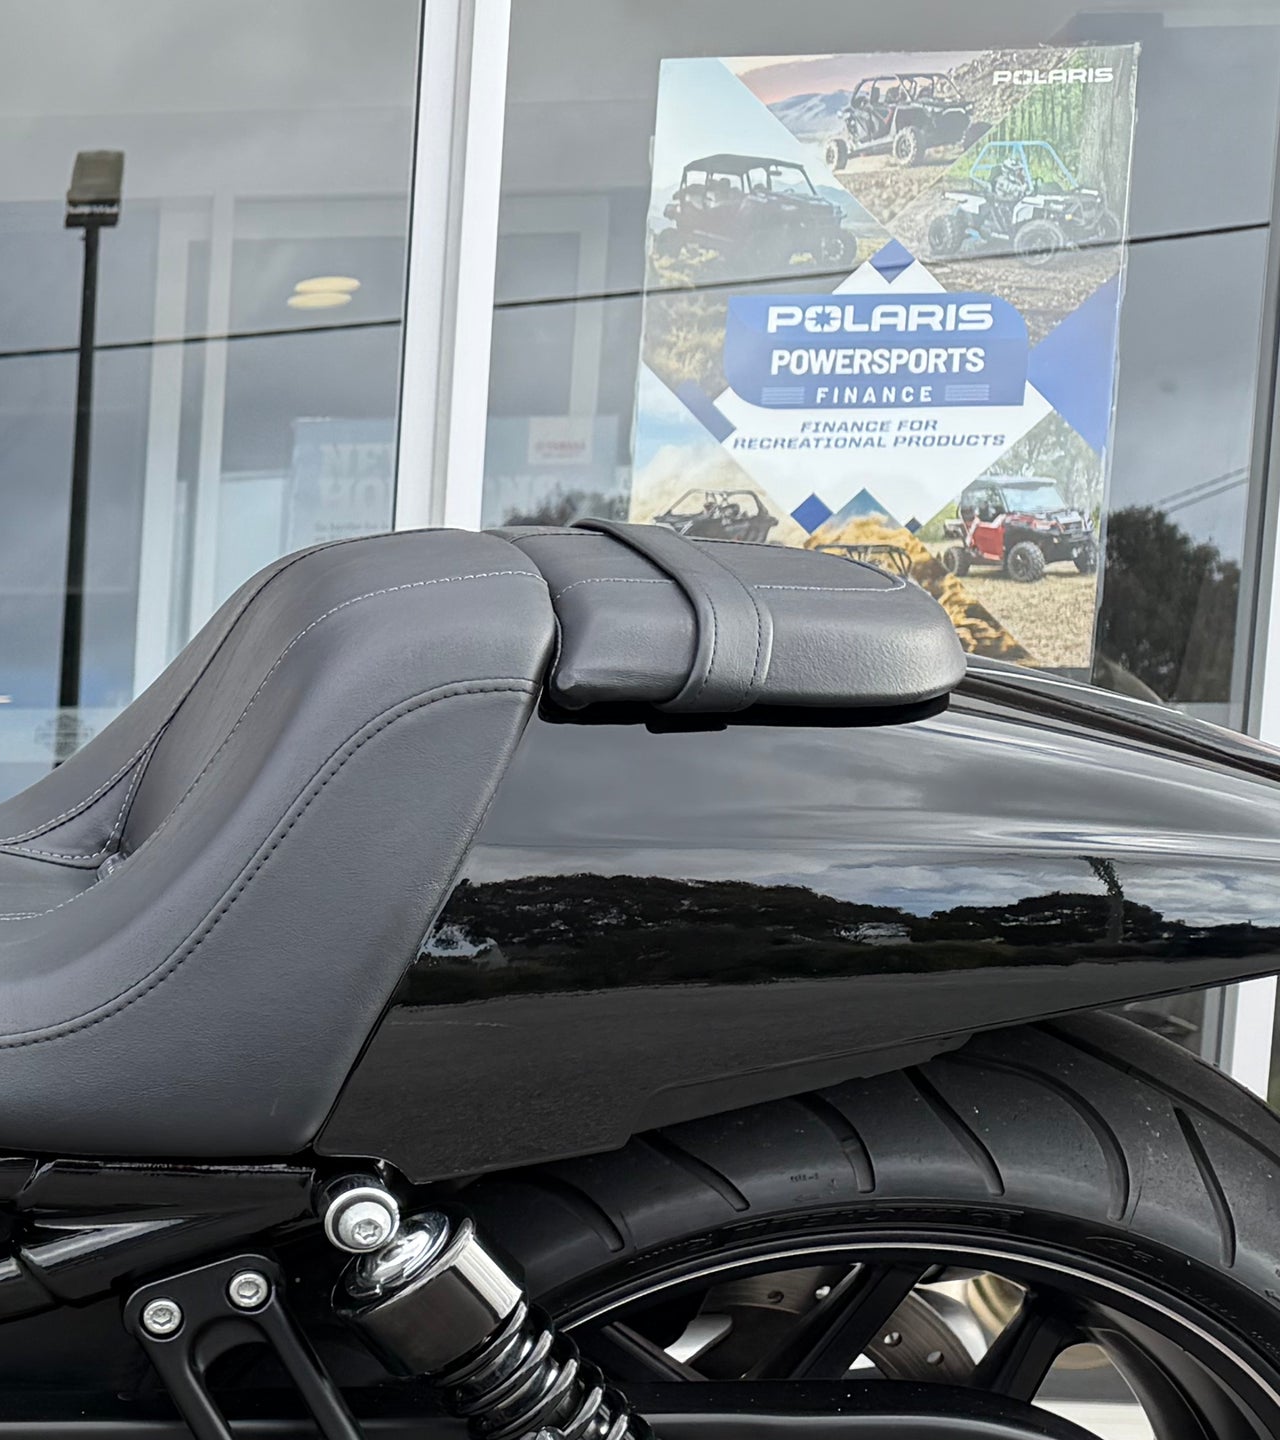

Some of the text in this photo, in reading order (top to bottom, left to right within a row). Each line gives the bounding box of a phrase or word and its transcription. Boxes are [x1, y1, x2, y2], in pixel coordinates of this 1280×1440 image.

[992, 67, 1114, 86] POLARIS
[767, 303, 993, 334] POLARIS
[771, 347, 986, 375] POWERSPORTS
[816, 386, 933, 404] FINANCE
[800, 419, 938, 434] FINANCE FOR
[733, 434, 1006, 450] RECREATIONAL PRODUCTS
